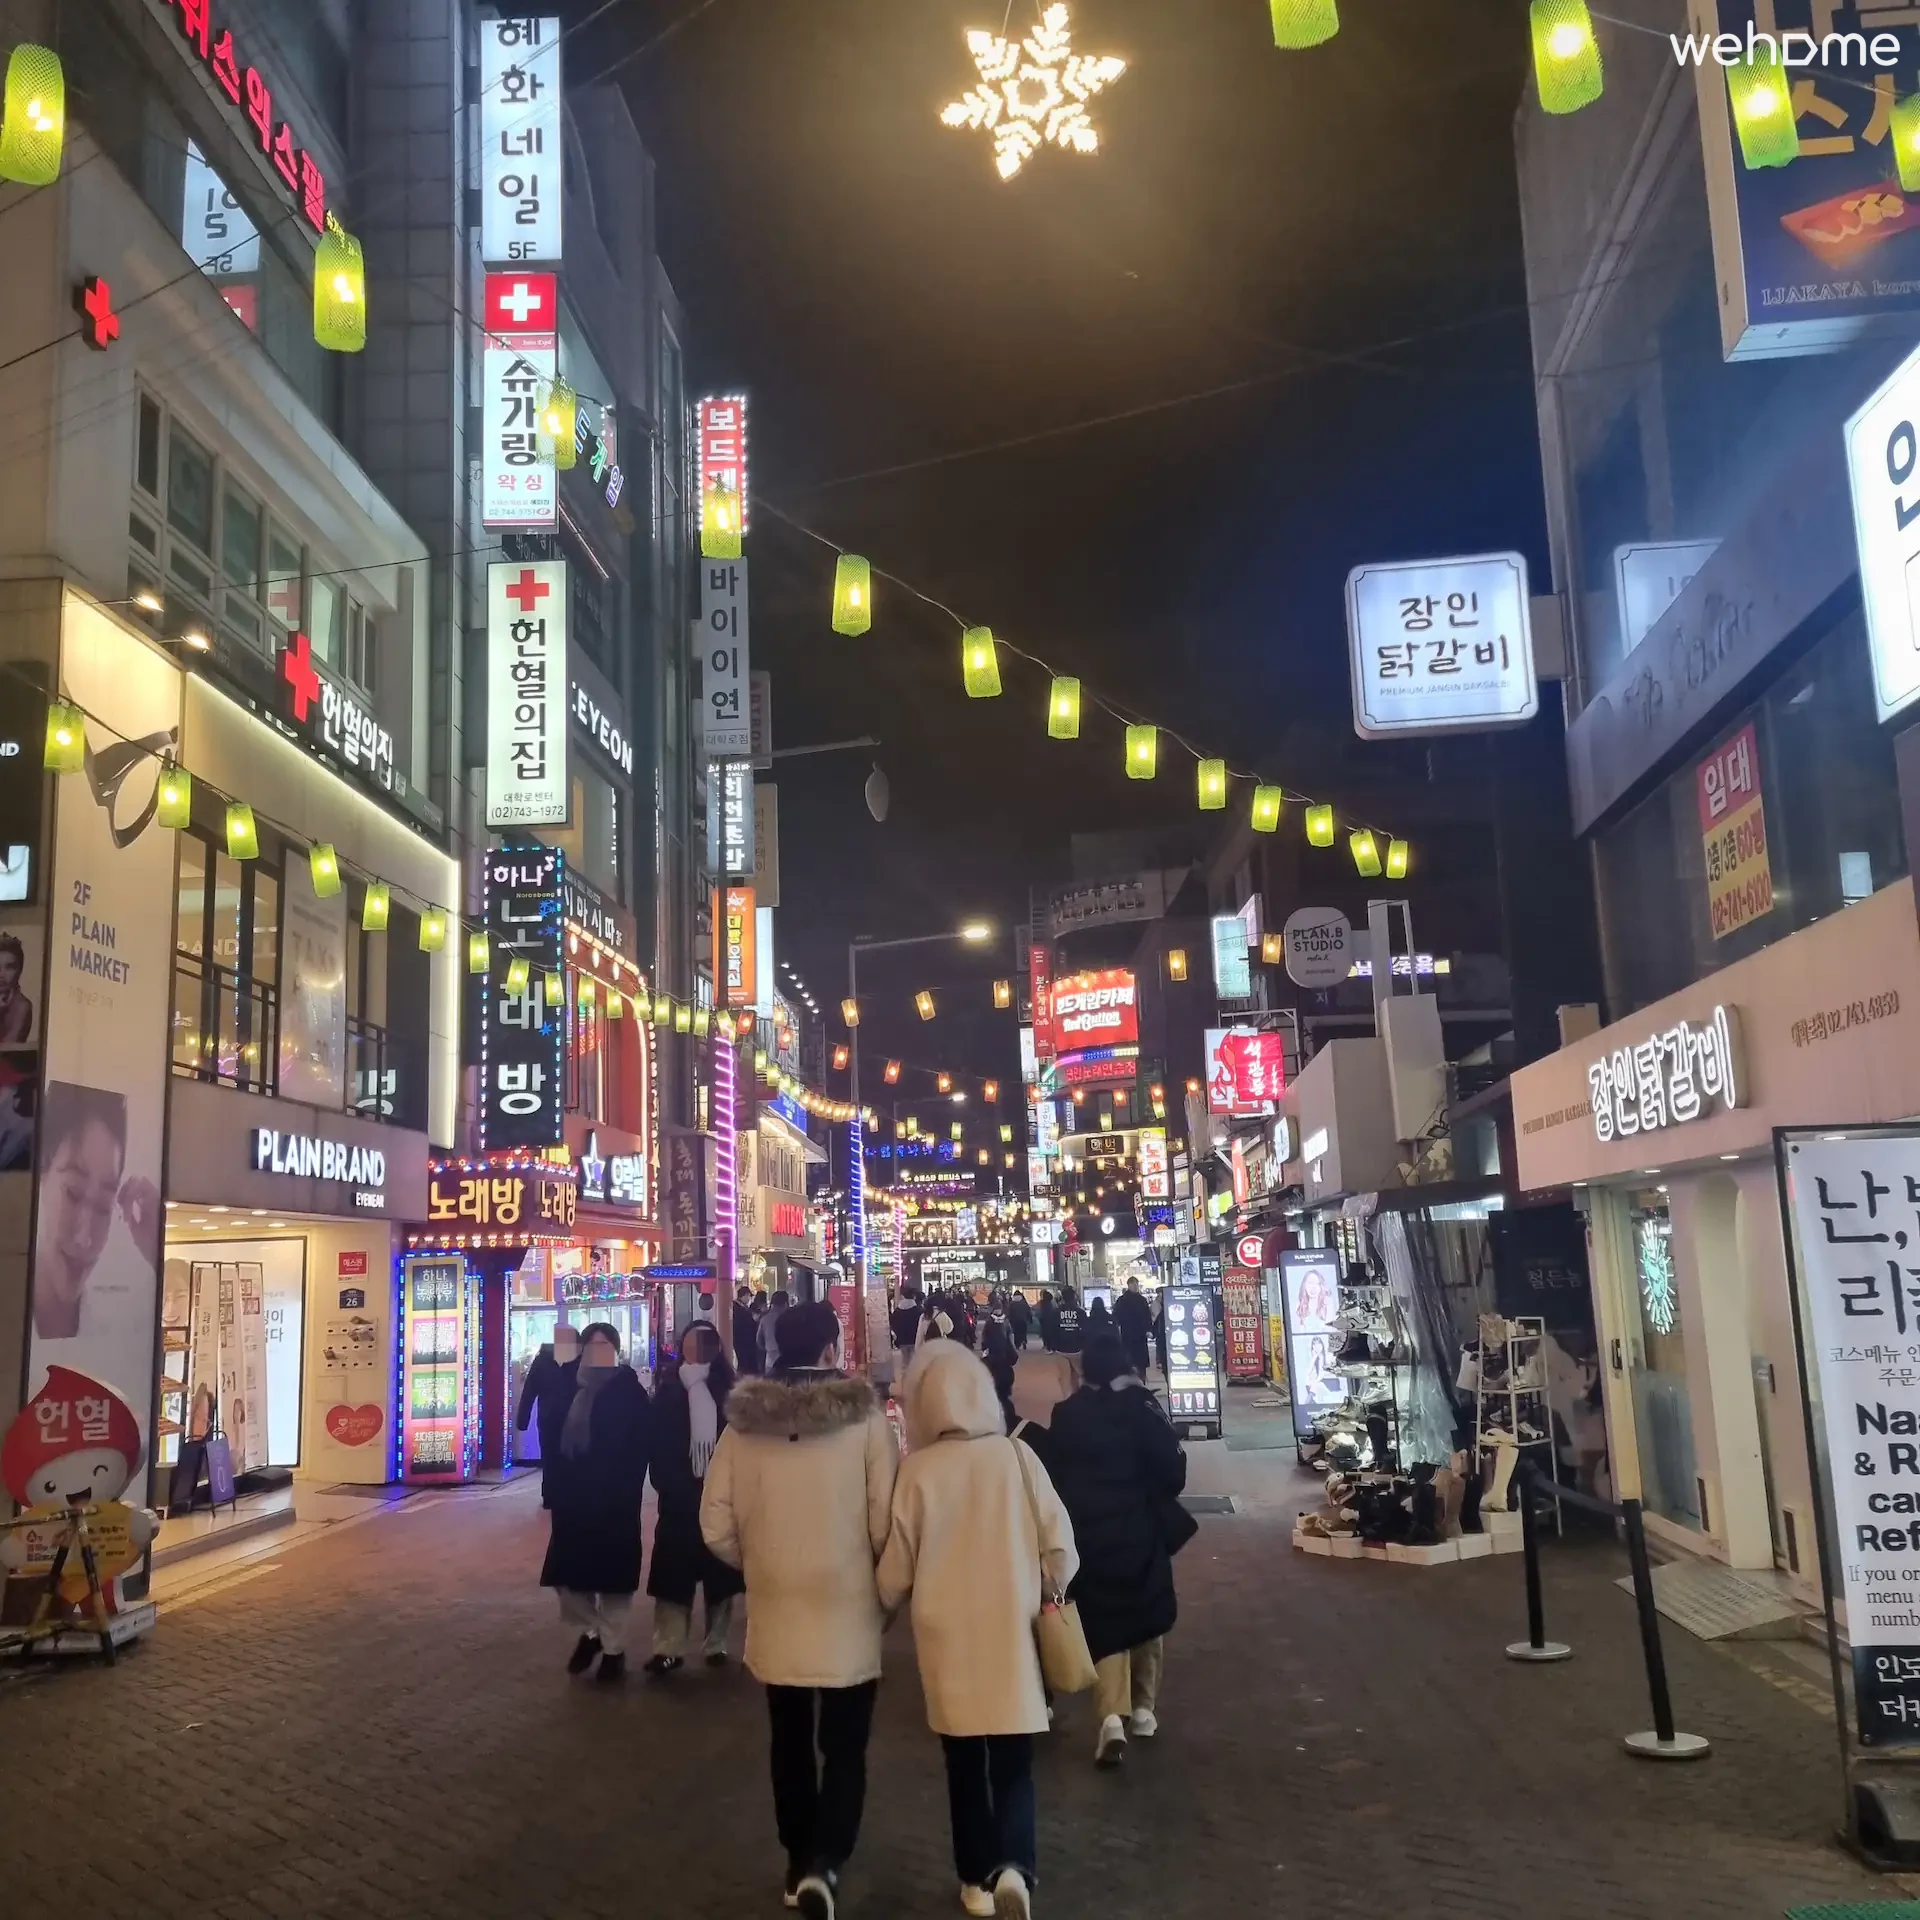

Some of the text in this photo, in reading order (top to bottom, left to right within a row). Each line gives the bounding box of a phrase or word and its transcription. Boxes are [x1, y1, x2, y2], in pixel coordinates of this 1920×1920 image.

[496, 17, 545, 225] 혜화네일
[507, 241, 537, 260] 5F
[501, 360, 539, 467] 슈가링
[1399, 591, 1479, 631] 장인
[710, 565, 740, 721] 바이이연
[1376, 634, 1510, 679] 닭갈비
[510, 618, 546, 781] 헌혈의집
[1379, 685, 1425, 697] PREMIUM
[322, 681, 394, 791] 헌혈의집
[1703, 736, 1752, 819] 임대
[503, 790, 554, 804] 대학로센터
[491, 804, 565, 820] (02)743-1972
[493, 864, 545, 887] 하나
[73, 880, 91, 906] 2F
[71, 912, 116, 950] PLAIN
[1292, 926, 1344, 940] PLAN.B
[1293, 939, 1345, 953] STUDIO
[69, 944, 130, 985] MARKET
[498, 899, 547, 1116] 노래방
[1587, 1003, 1737, 1142] 장인닭갈비
[355, 1191, 385, 1208] EYEWEAR
[428, 1177, 525, 1226] 노래방
[540, 1179, 578, 1228] 노래방
[1813, 1169, 1909, 1251] 난,
[422, 1268, 448, 1282] 하나
[416, 1281, 454, 1296] 노래방
[346, 1298, 358, 1307] 26
[1060, 1310, 1078, 1320] DEUS
[1829, 1345, 1901, 1364] 코스메뉴
[1878, 1367, 1920, 1388] 주문
[34, 1397, 111, 1444] 헌혈
[1855, 1401, 1920, 1436] Na
[1854, 1451, 1876, 1476] &
[1848, 1565, 1861, 1582] If
[1864, 1570, 1896, 1585] you
[1867, 1592, 1913, 1604] menu
